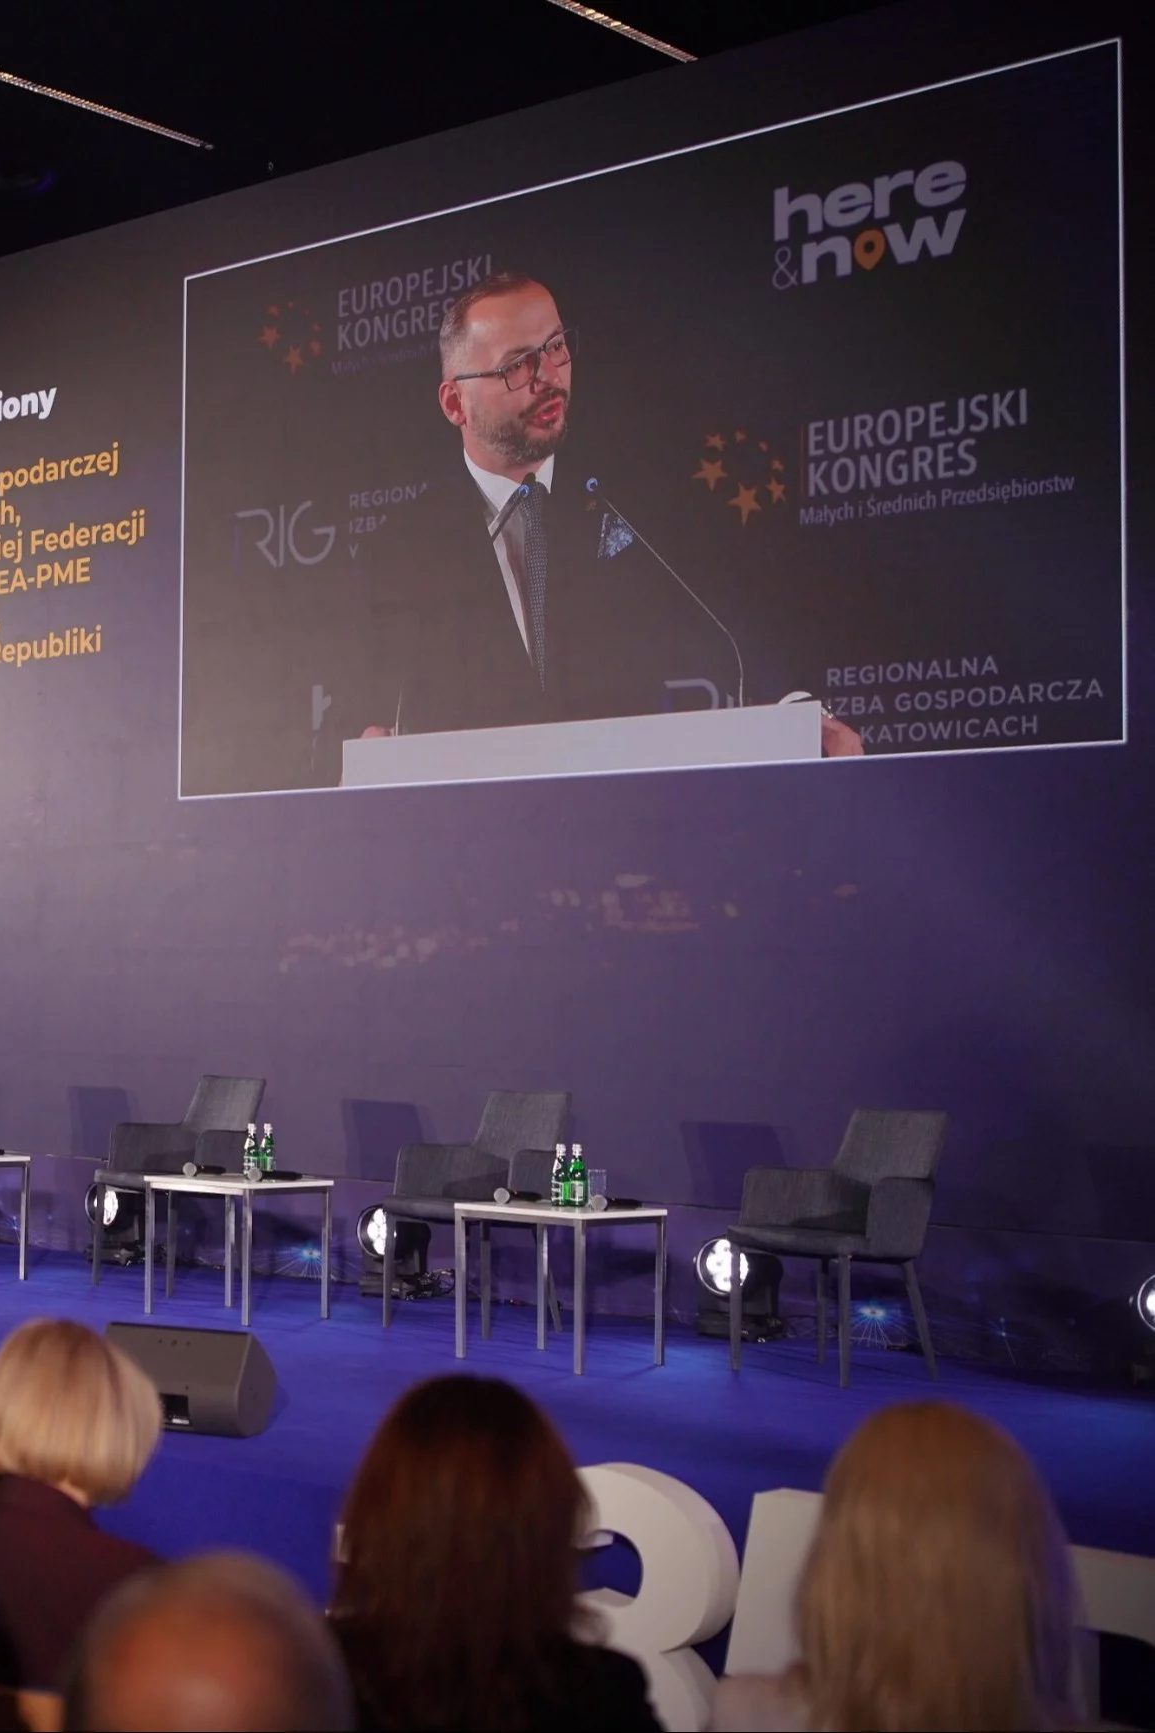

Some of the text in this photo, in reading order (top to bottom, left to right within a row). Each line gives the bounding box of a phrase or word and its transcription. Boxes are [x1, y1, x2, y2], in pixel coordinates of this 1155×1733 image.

[773, 160, 967, 241] here
[337, 254, 493, 318] EUROPEJSKI
[807, 388, 1029, 457] EUROPEJSKI
[807, 438, 978, 497] KONGRES
[799, 474, 1075, 527] Małych i Średnich Przedsiębiorstw
[30, 509, 147, 555] Federacji
[234, 500, 337, 569] RIG
[826, 655, 999, 687] REGIONALNA
[895, 678, 1104, 713] GOSPODARCZA
[860, 714, 1038, 745] KATOWICACH
